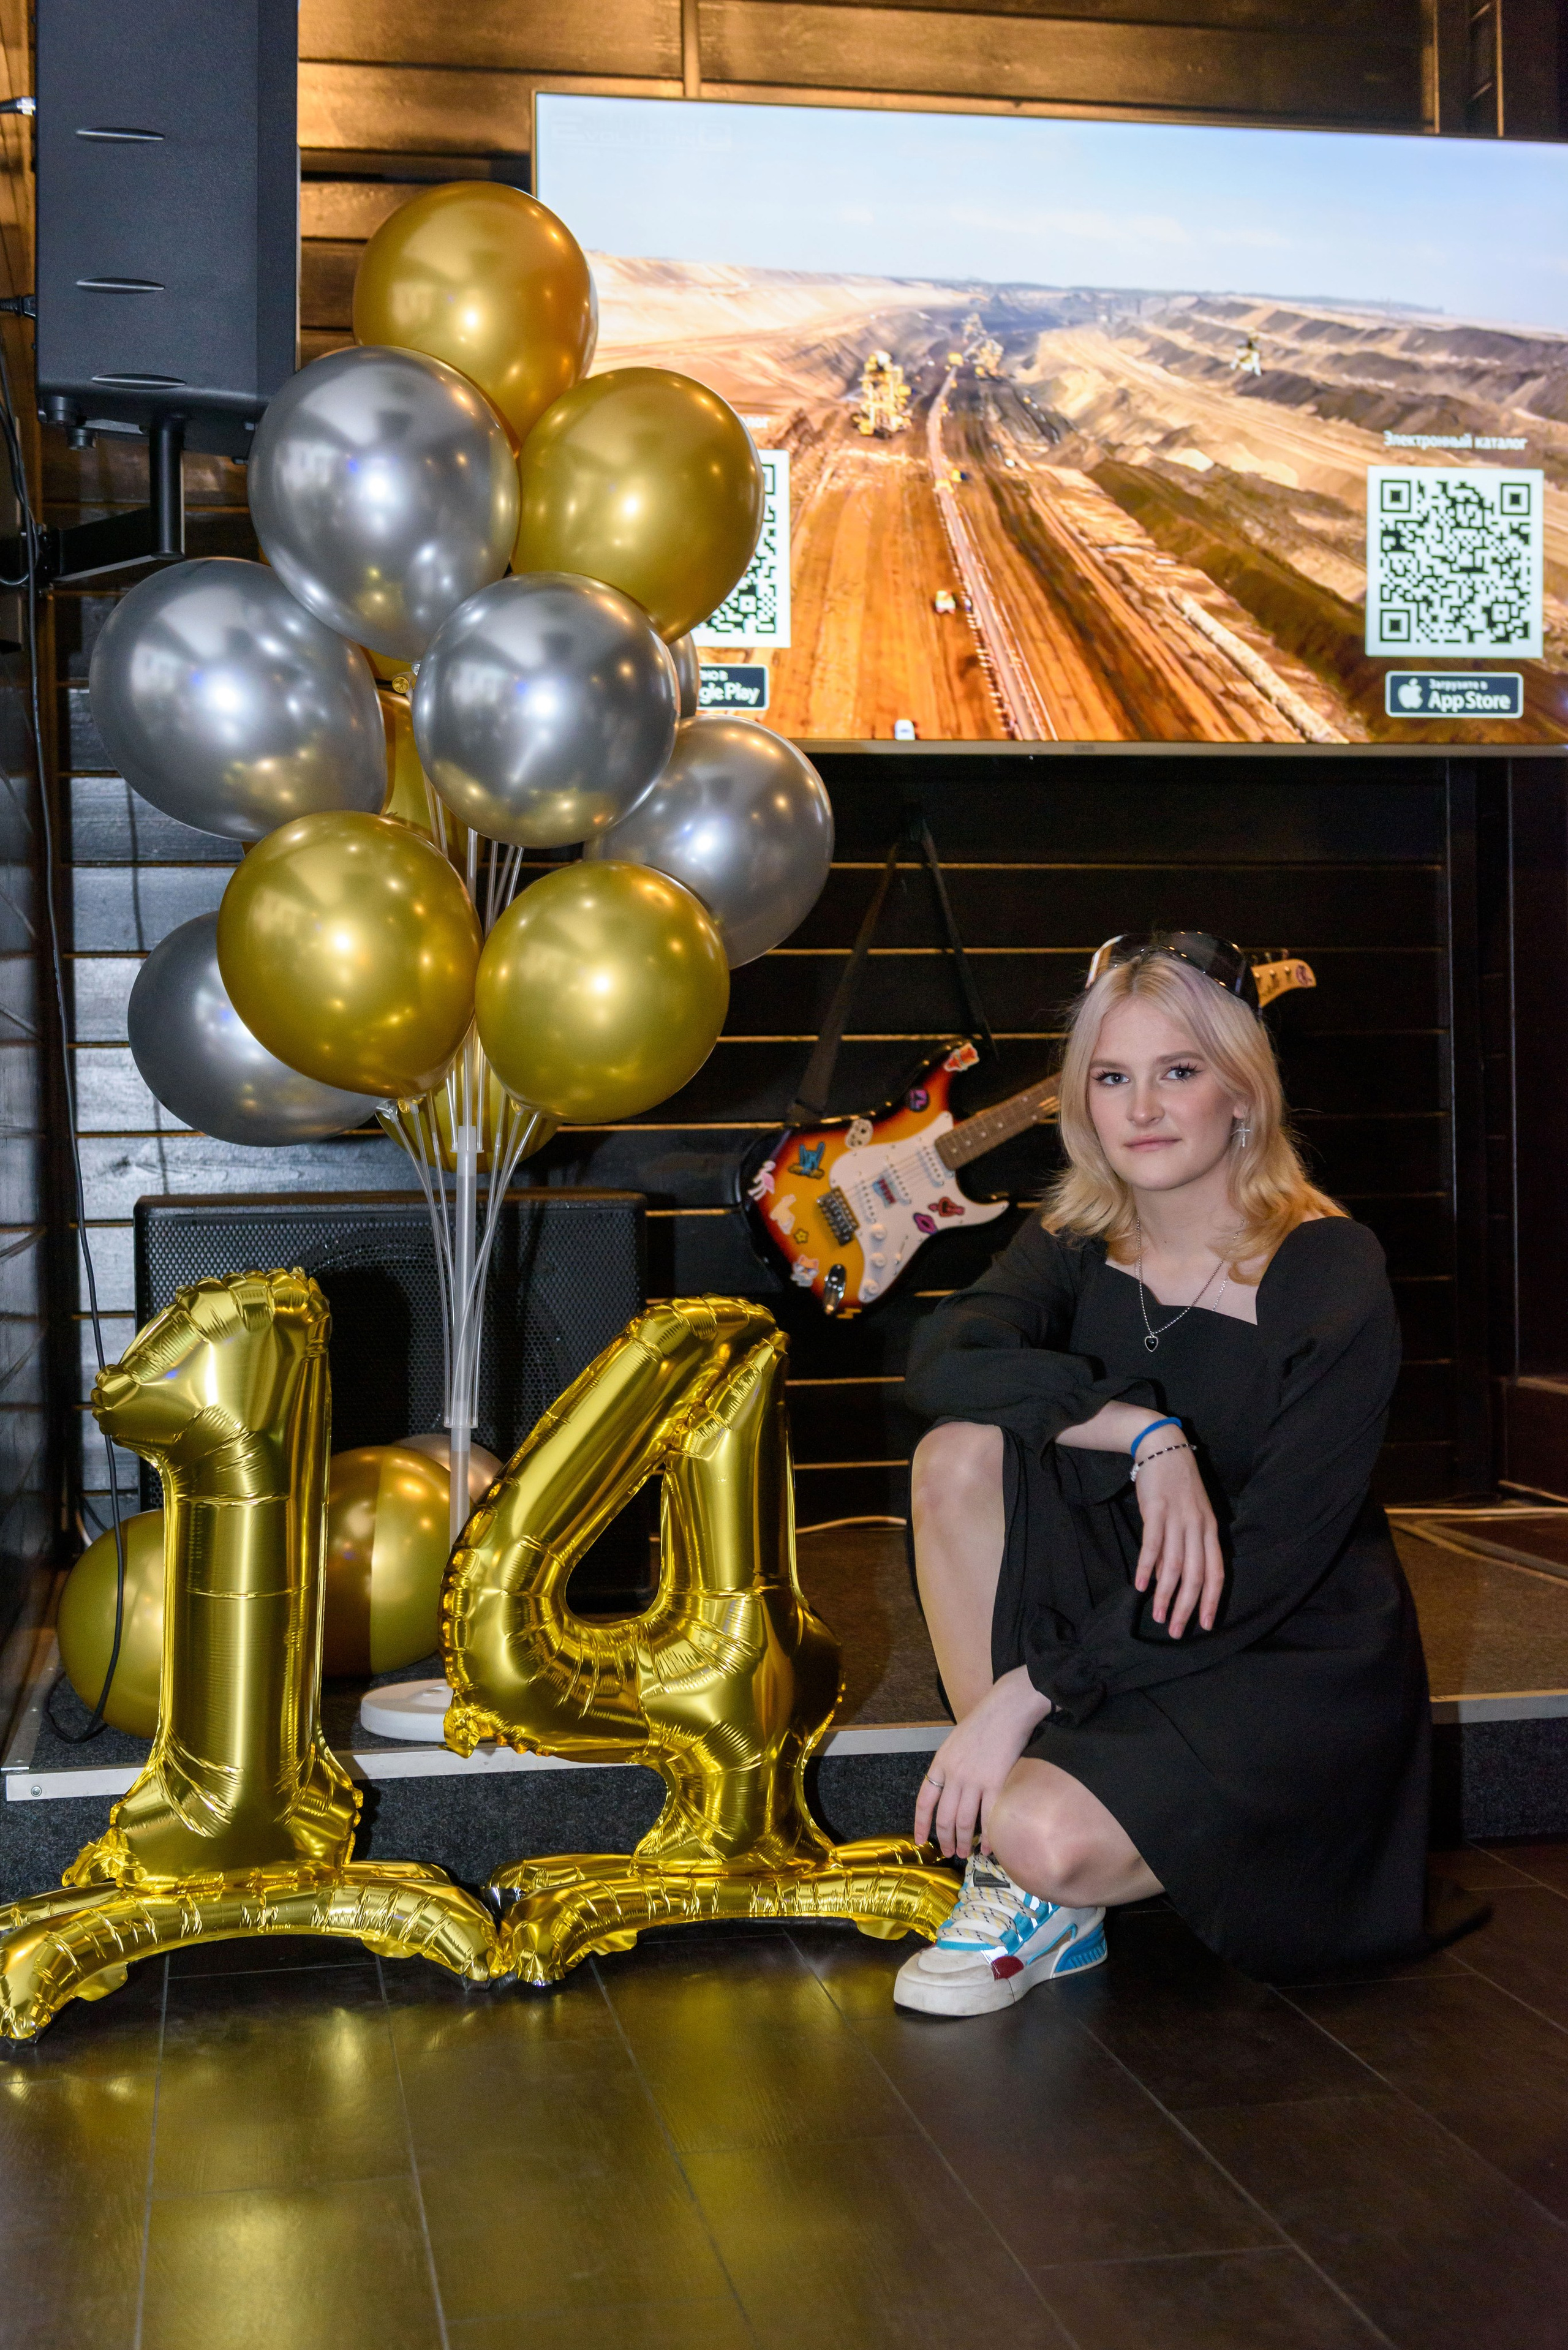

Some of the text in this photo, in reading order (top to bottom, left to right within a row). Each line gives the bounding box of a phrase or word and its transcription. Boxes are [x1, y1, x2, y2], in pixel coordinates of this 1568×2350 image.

[1383, 430, 1528, 451] Электронный каталог
[698, 682, 760, 705] gle Play
[1427, 690, 1512, 713] App Store
